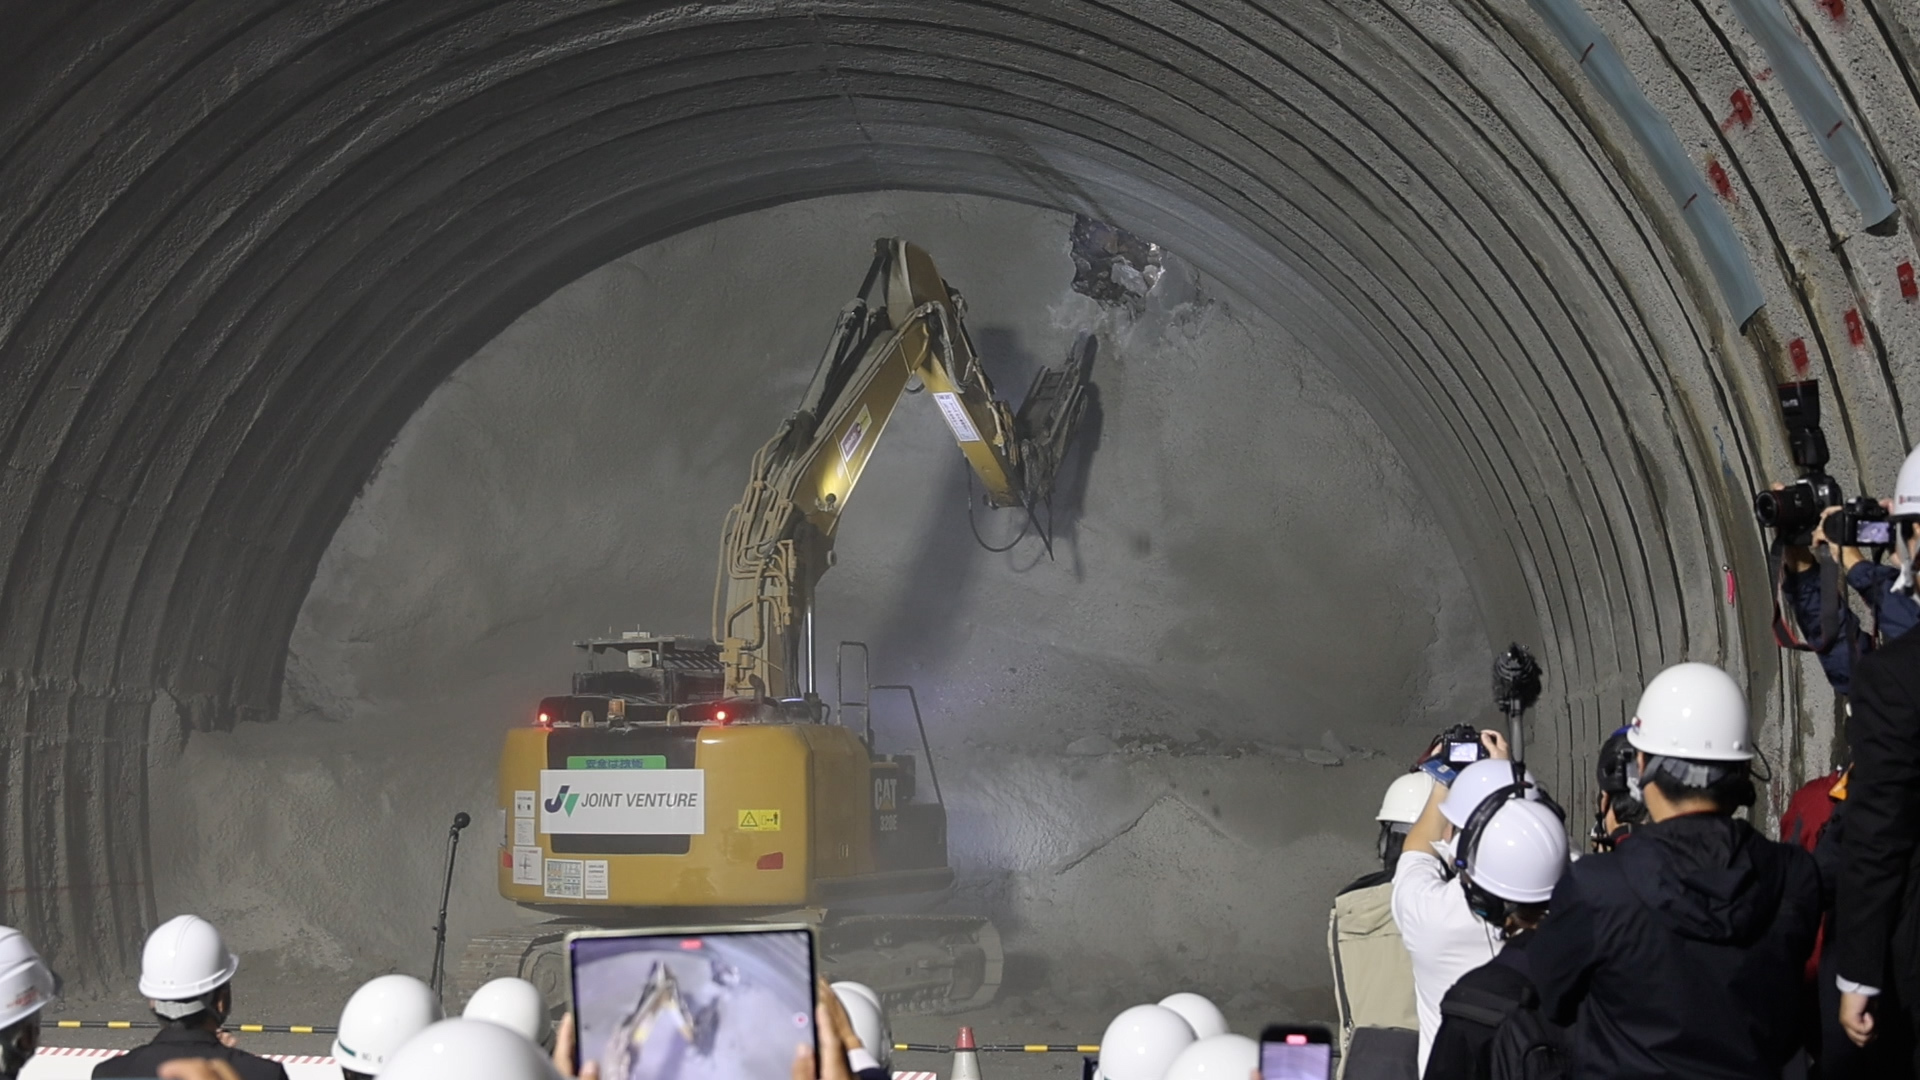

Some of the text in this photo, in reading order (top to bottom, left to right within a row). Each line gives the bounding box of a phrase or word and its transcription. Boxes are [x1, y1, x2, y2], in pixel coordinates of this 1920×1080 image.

[581, 793, 698, 808] JOINT VENTURE
[875, 778, 897, 810] CAT
